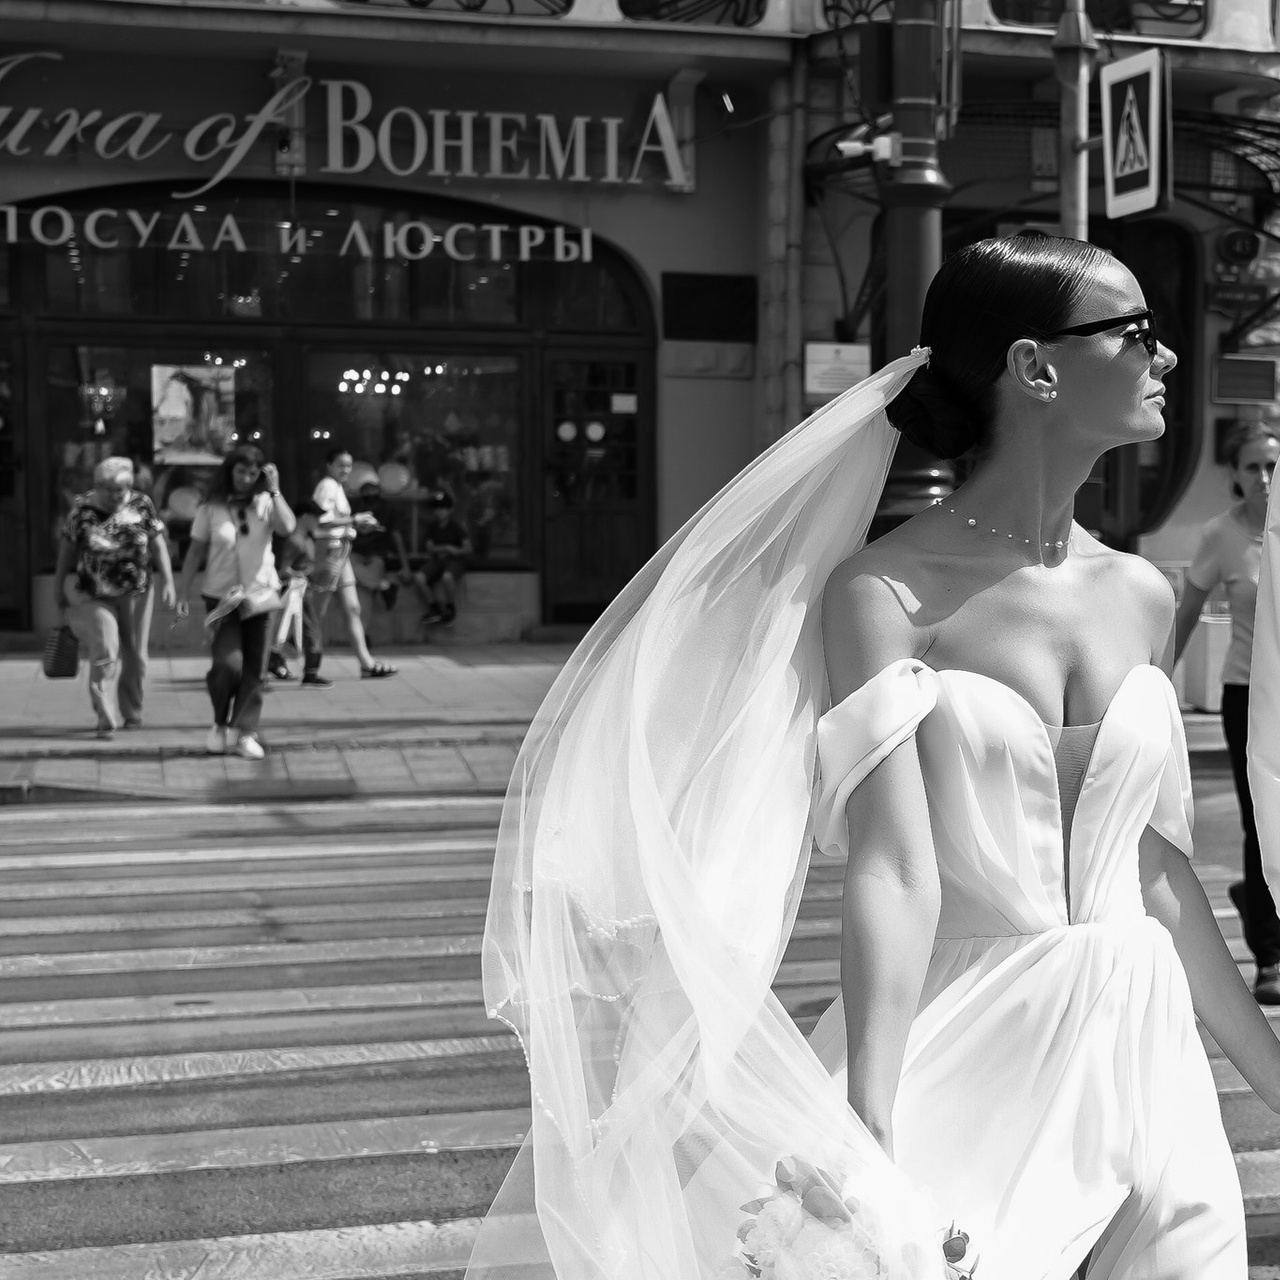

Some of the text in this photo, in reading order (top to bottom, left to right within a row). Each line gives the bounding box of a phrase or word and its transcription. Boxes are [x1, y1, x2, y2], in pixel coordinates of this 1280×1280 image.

[0, 52, 696, 199] ura of BOHEMIA
[339, 220, 592, 262] ЛЮСТРЫ
